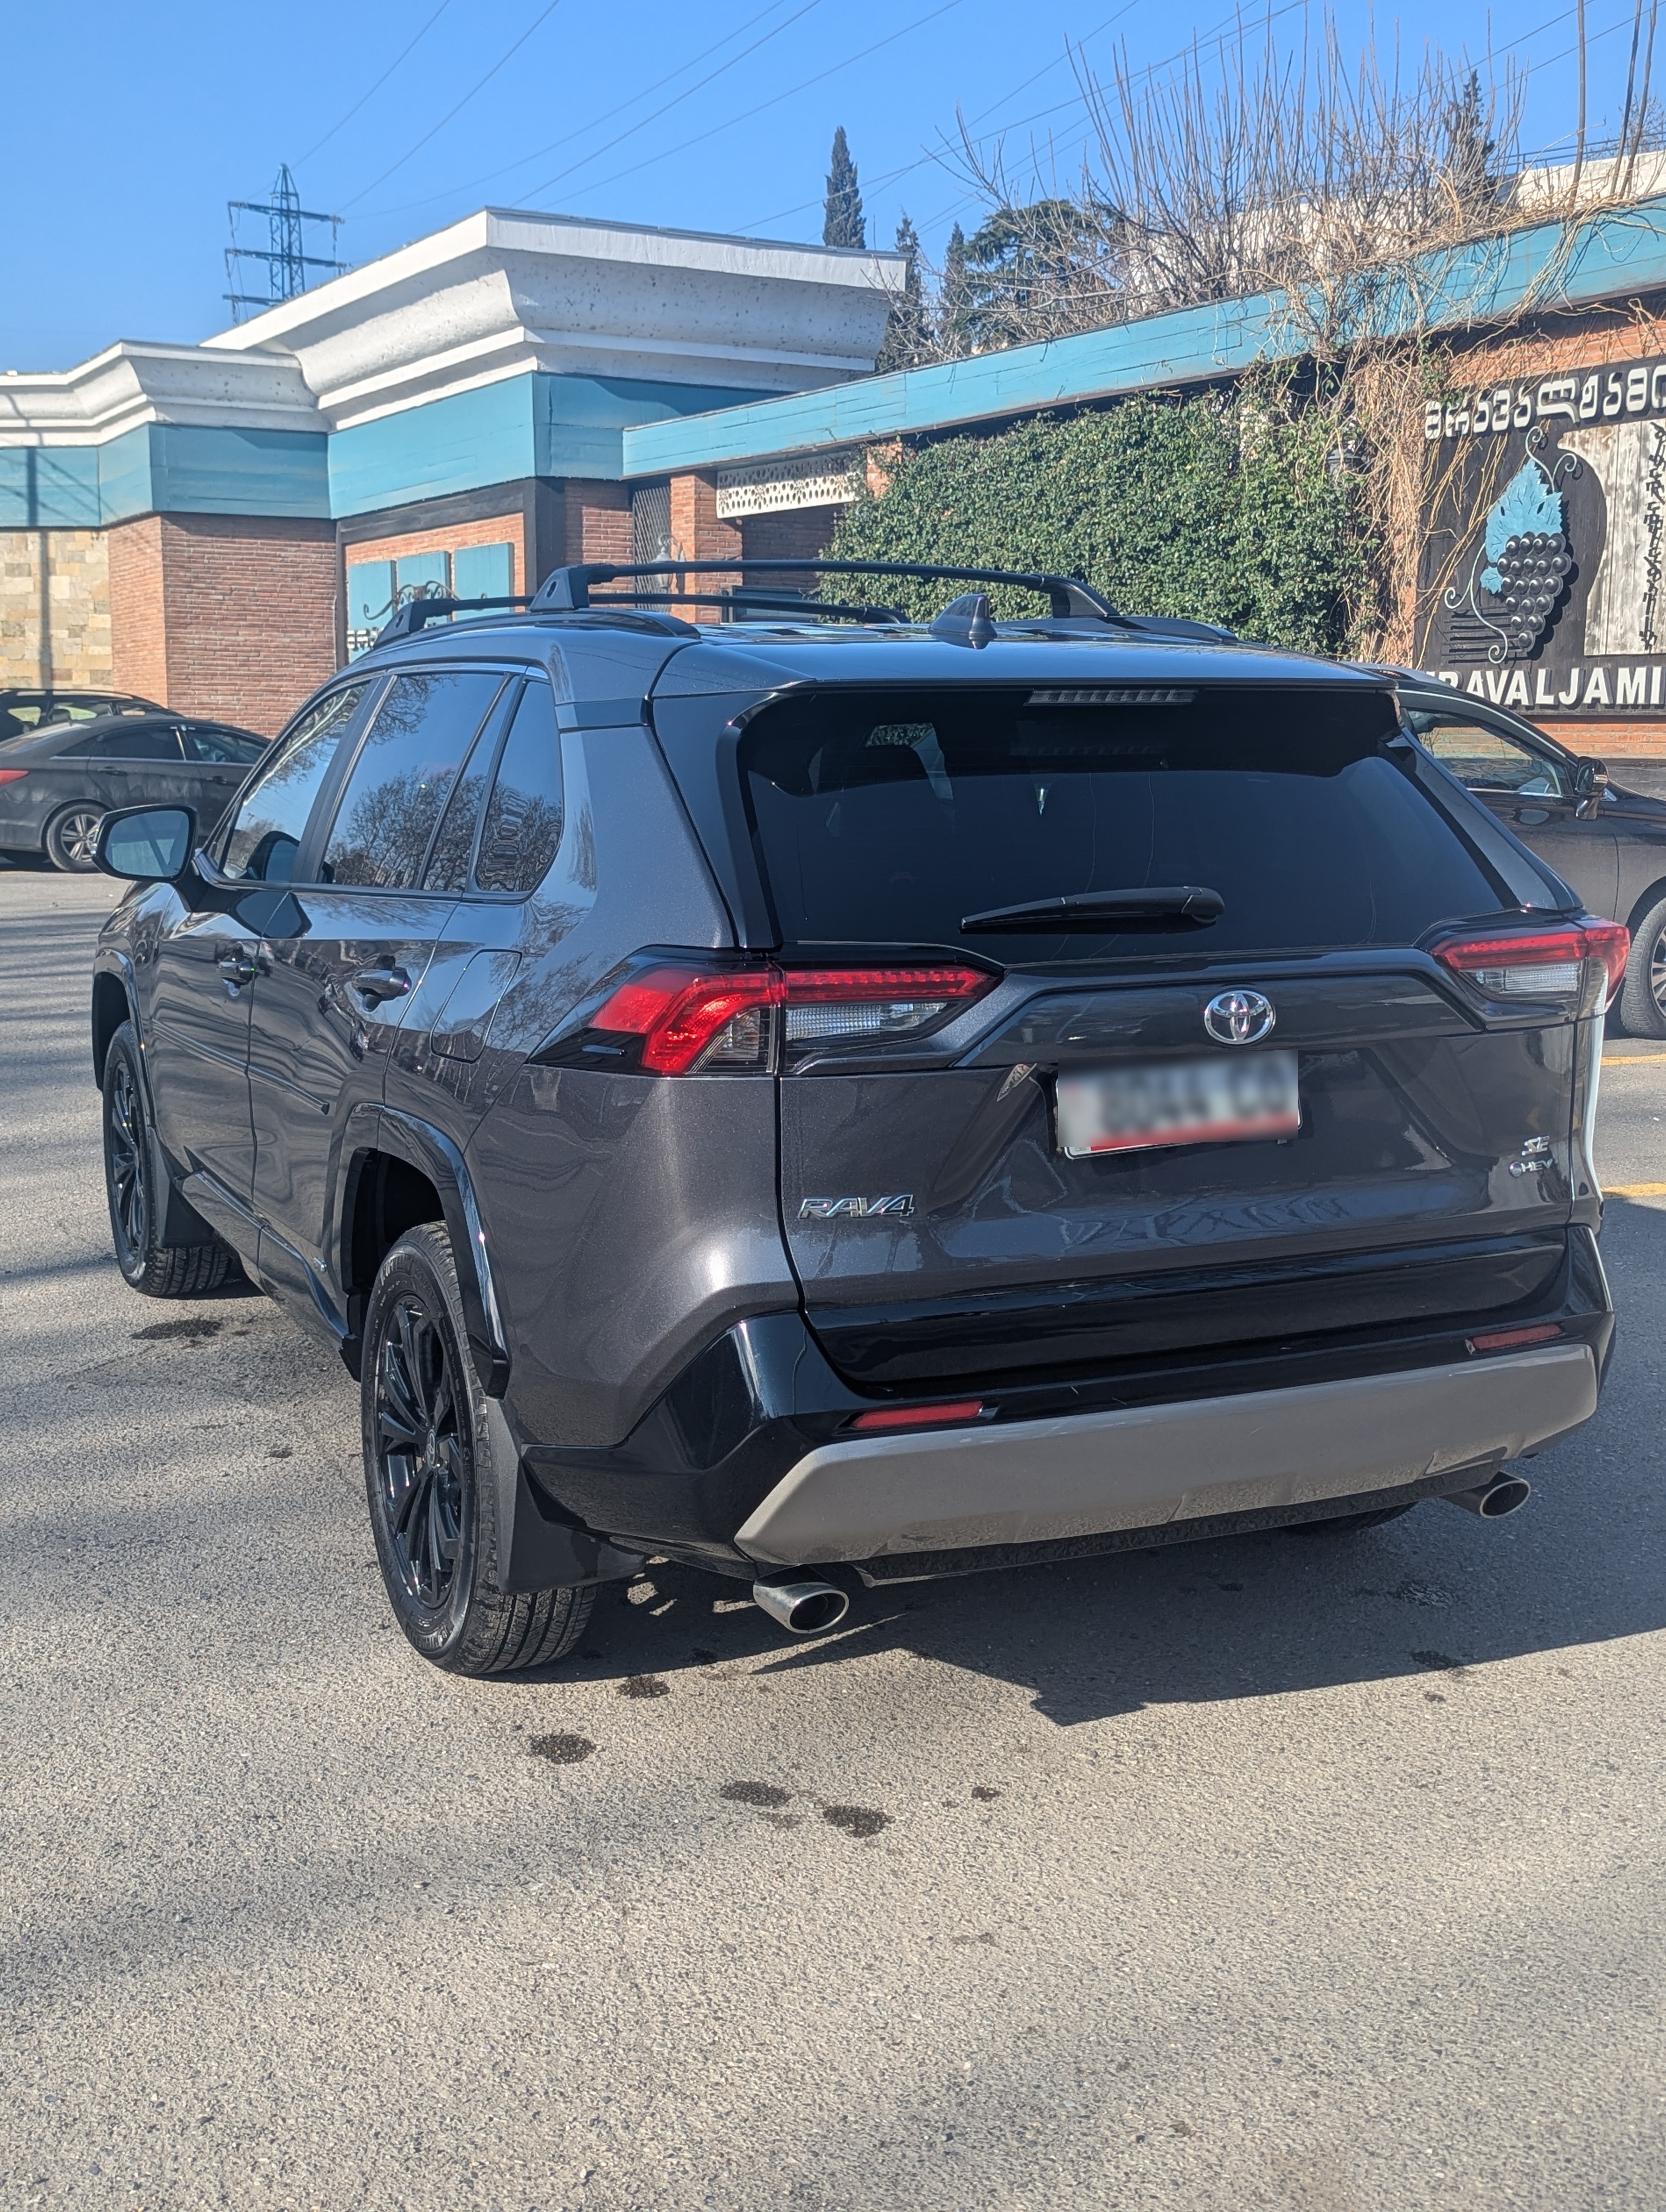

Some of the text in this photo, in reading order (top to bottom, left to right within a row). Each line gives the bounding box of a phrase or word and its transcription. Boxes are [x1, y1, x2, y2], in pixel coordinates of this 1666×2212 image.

[1426, 665, 1663, 706] AVALJAMI
[1521, 1136, 1549, 1156] SE
[798, 1194, 915, 1219] RAV4
